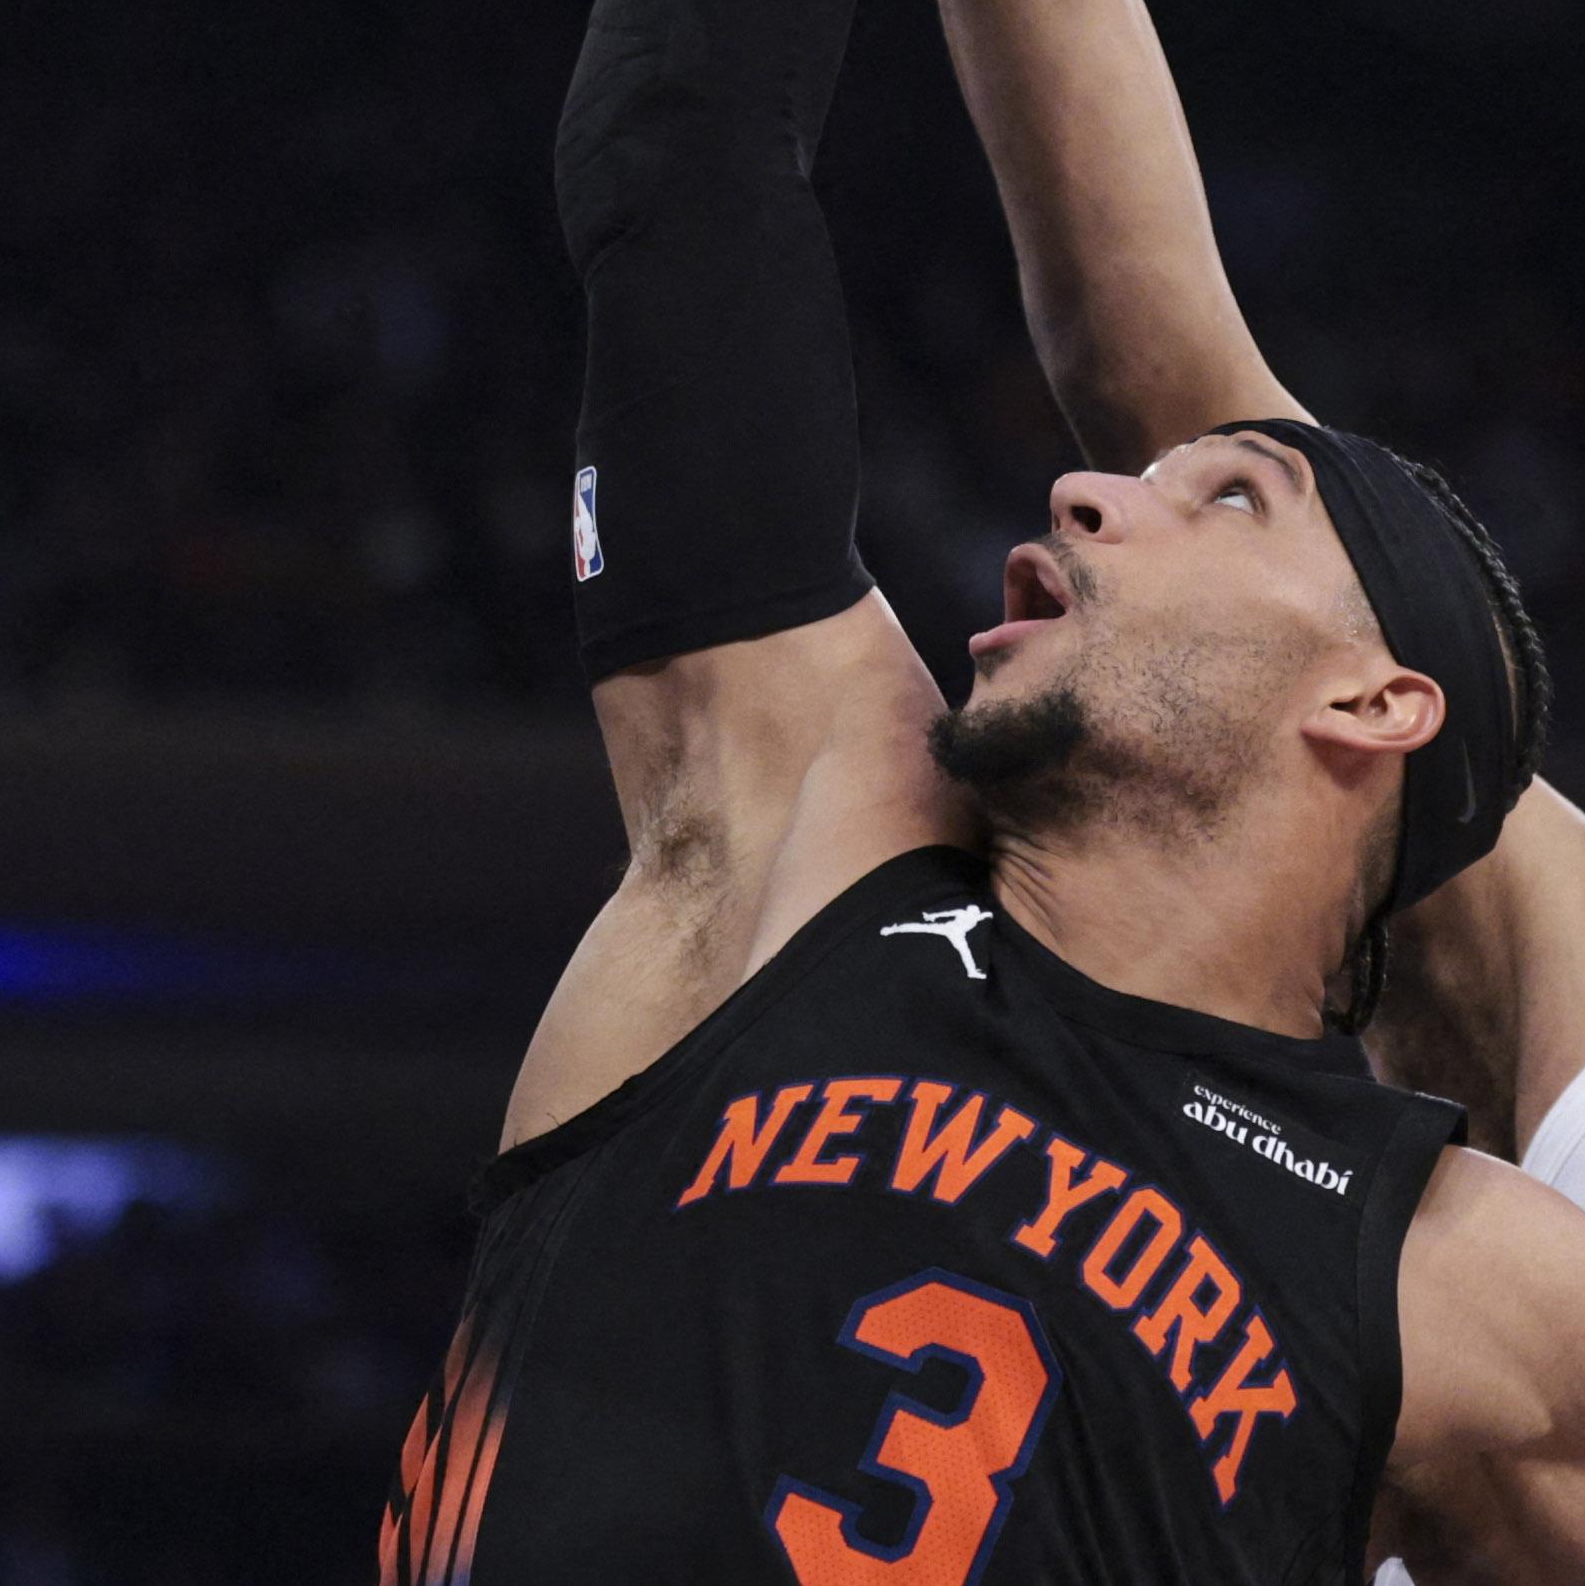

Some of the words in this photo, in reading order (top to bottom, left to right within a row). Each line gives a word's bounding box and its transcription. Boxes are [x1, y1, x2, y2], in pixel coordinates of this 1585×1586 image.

[1182, 1101, 1249, 1145] abu
[1193, 1084, 1282, 1135] experience
[675, 1074, 1036, 1210] NEW
[1013, 1133, 1298, 1507] YORK
[765, 1267, 1060, 1586] 3
